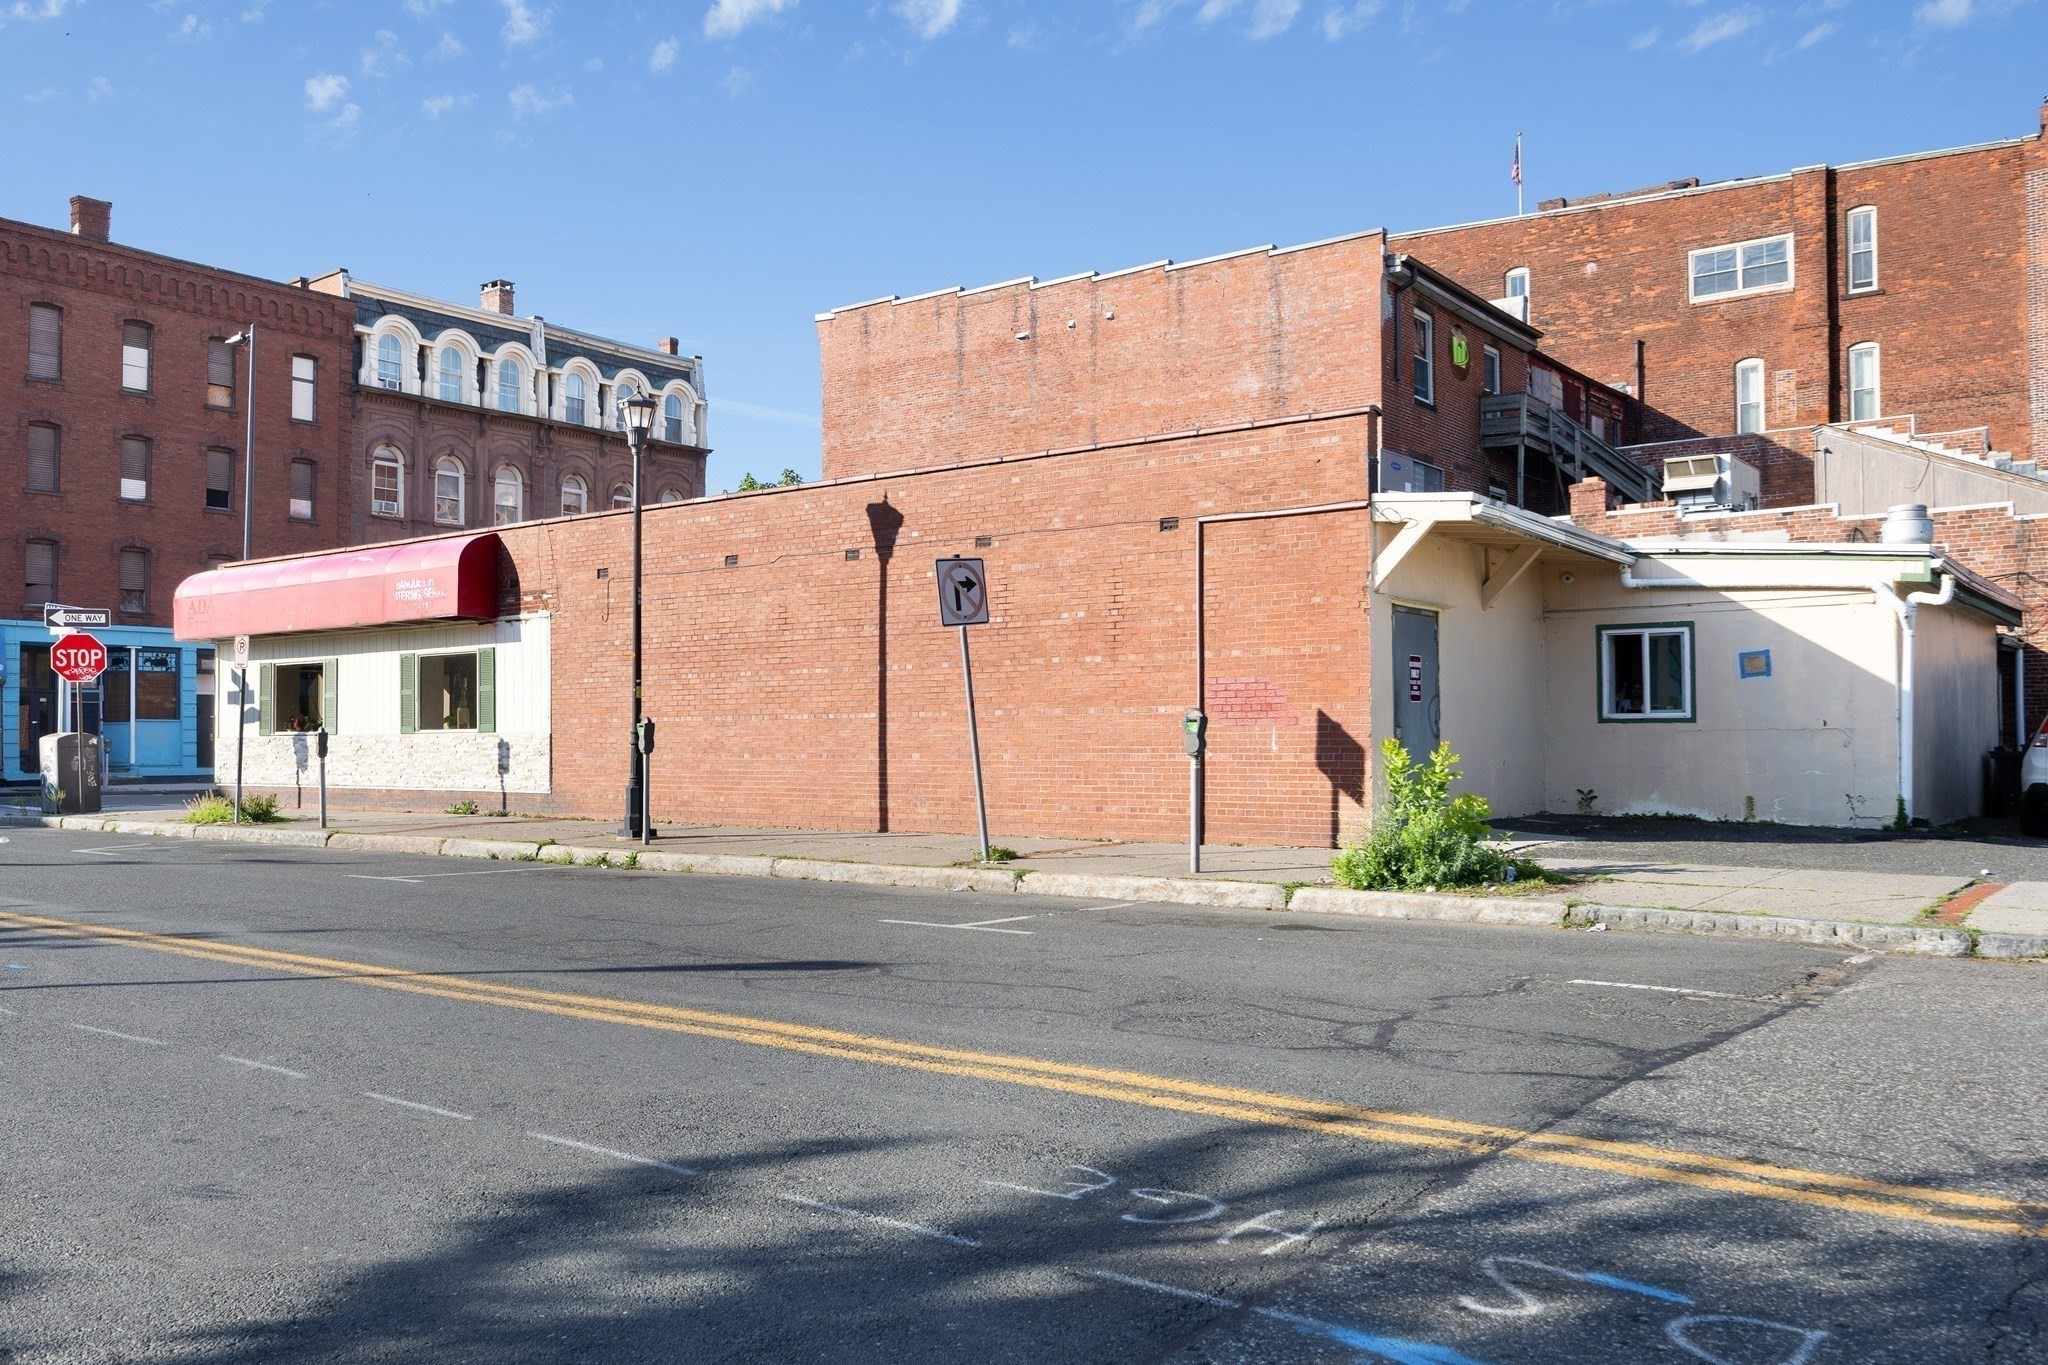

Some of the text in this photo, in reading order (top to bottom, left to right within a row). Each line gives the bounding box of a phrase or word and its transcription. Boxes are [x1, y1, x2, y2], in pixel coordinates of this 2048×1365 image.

[64, 614, 103, 622] ONE WAY
[55, 648, 103, 667] STOP
